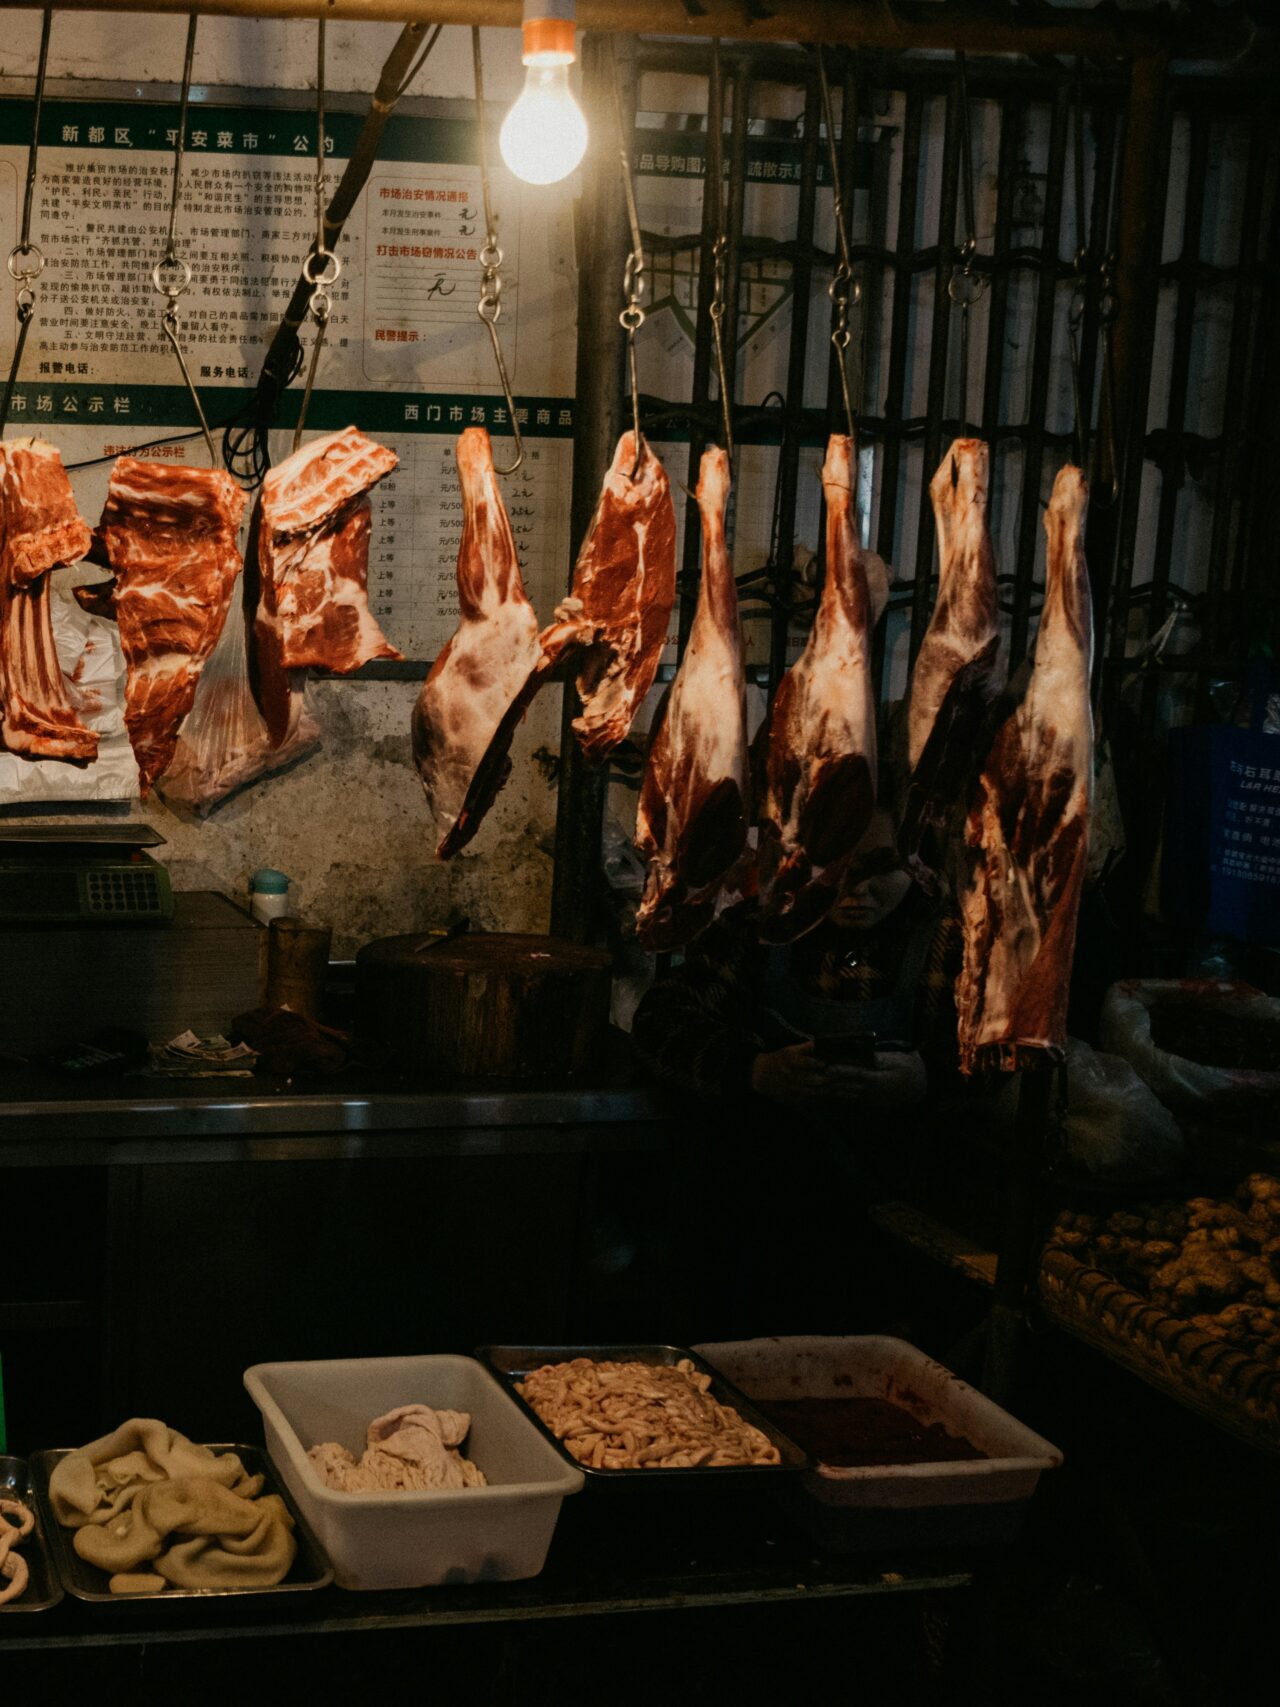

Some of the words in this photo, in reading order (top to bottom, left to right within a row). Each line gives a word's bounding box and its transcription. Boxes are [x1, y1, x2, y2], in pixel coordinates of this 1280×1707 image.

[379, 187, 469, 203] 市场治安情况通报
[375, 330, 426, 343] 民警提示：
[39, 361, 95, 375] 报警电话：
[200, 365, 255, 379] 服务电话：
[404, 404, 573, 426] 西门市场主要商品
